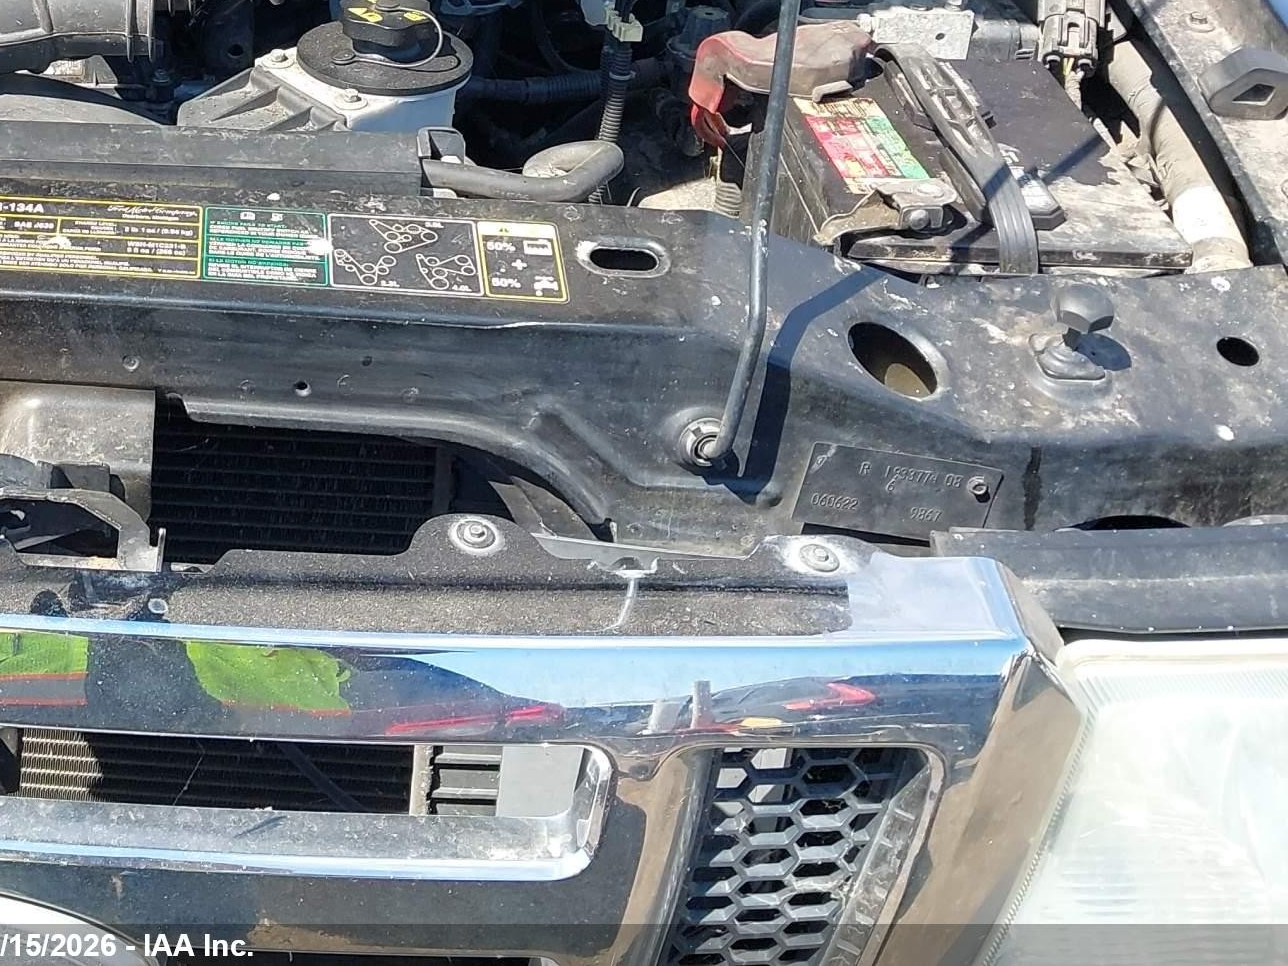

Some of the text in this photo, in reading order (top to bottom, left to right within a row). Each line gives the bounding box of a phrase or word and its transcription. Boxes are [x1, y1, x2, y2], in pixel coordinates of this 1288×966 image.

[487, 241, 516, 252] 50%
[492, 277, 521, 288] 50%
[859, 461, 872, 475] R
[811, 493, 859, 510] 060622
